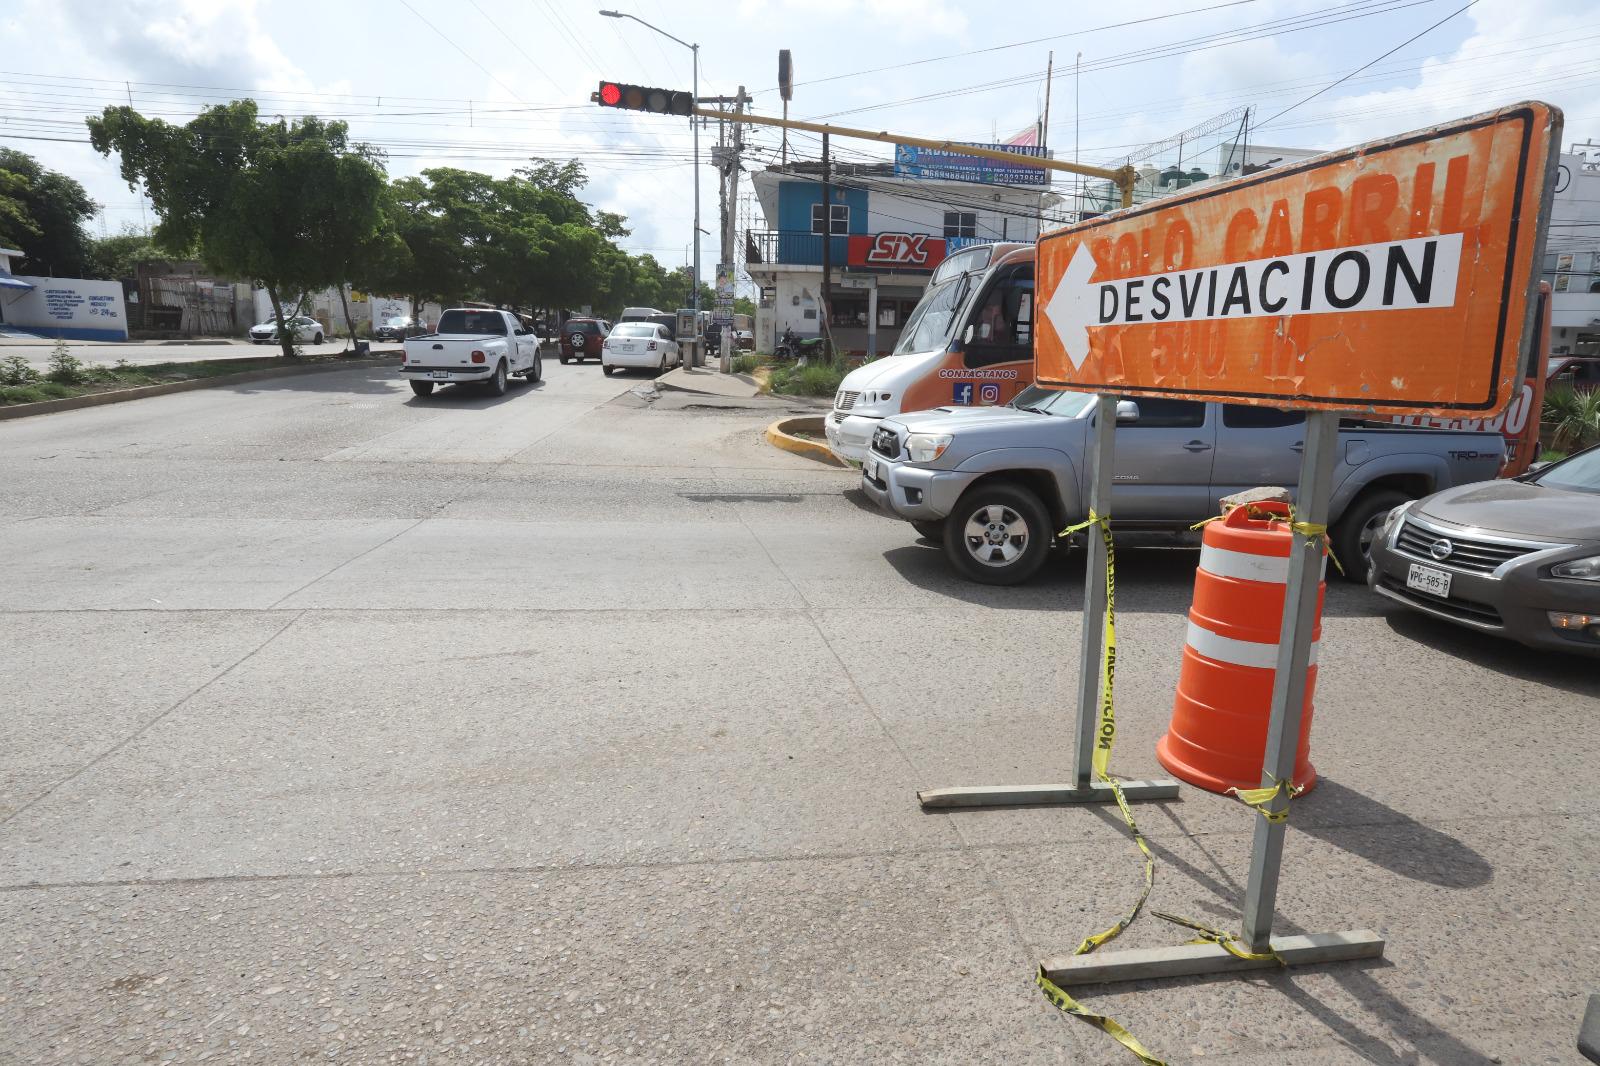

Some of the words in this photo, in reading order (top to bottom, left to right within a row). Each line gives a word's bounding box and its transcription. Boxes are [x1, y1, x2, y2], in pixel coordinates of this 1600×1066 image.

[1099, 240, 1438, 325] DESVIACION
[1448, 451, 1478, 461] TRD
[1410, 570, 1449, 591] VPG-585-B
